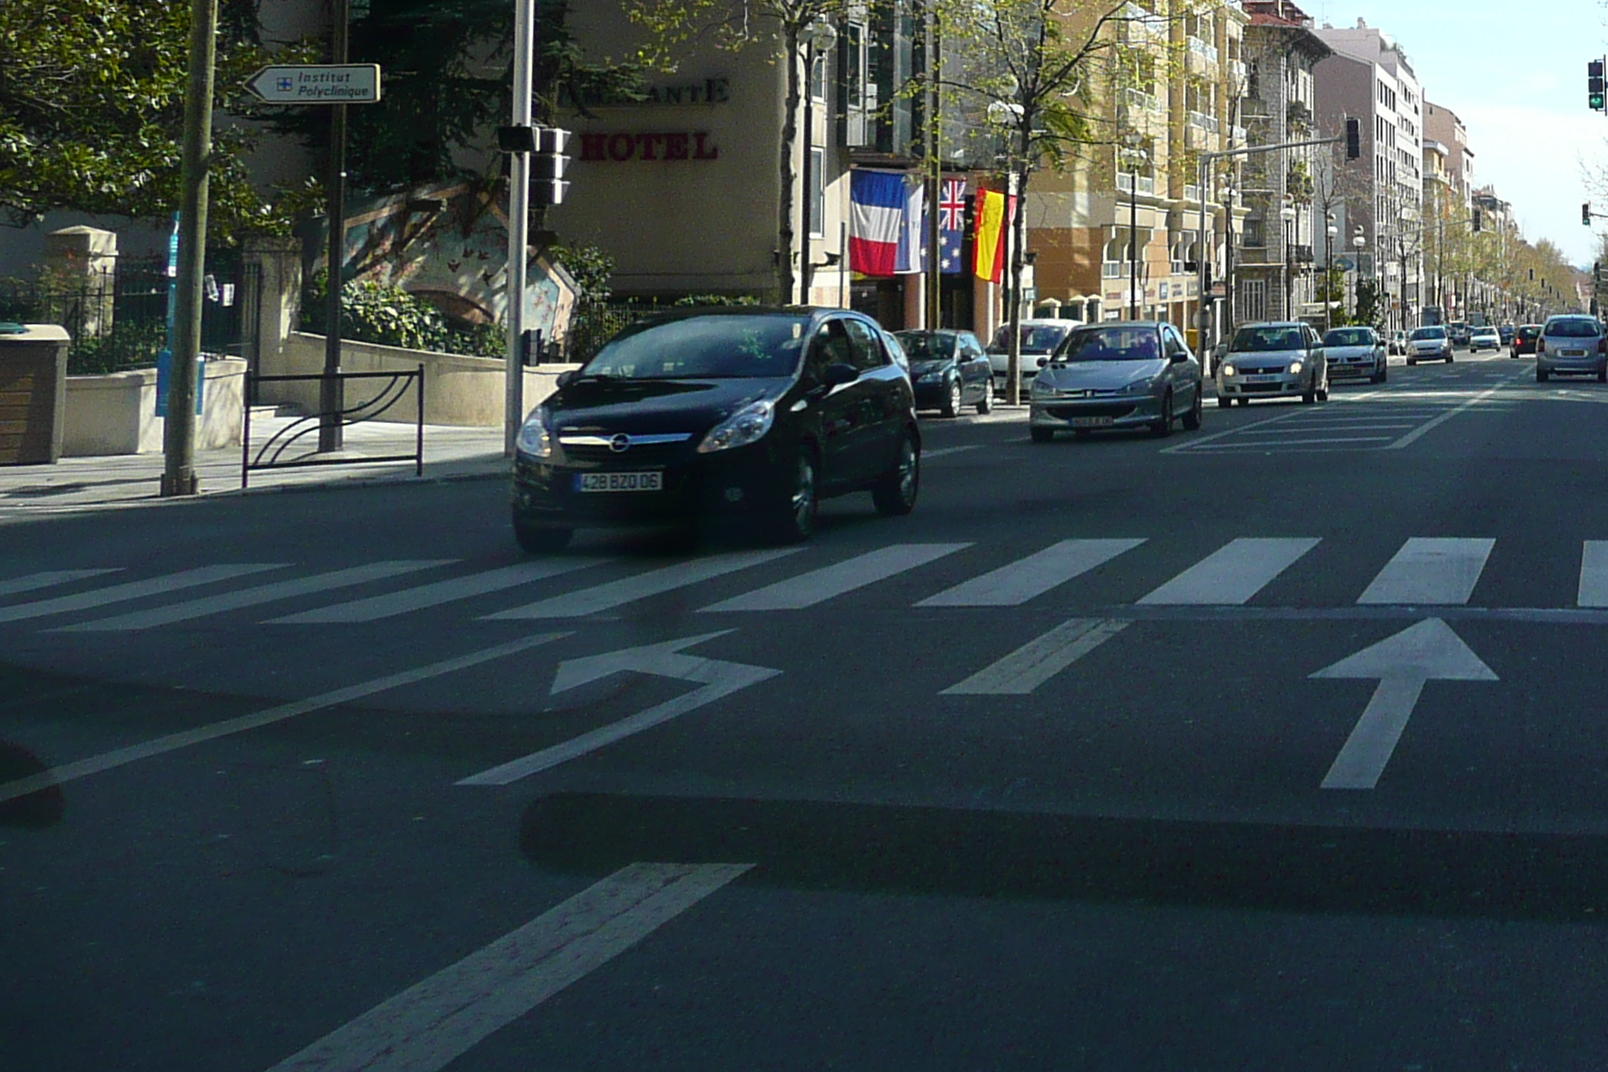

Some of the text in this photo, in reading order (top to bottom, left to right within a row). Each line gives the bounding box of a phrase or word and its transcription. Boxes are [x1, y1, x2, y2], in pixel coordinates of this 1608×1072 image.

[298, 71, 350, 83] Institut
[298, 85, 369, 98] Polyclinique
[579, 132, 718, 162] HOTEL
